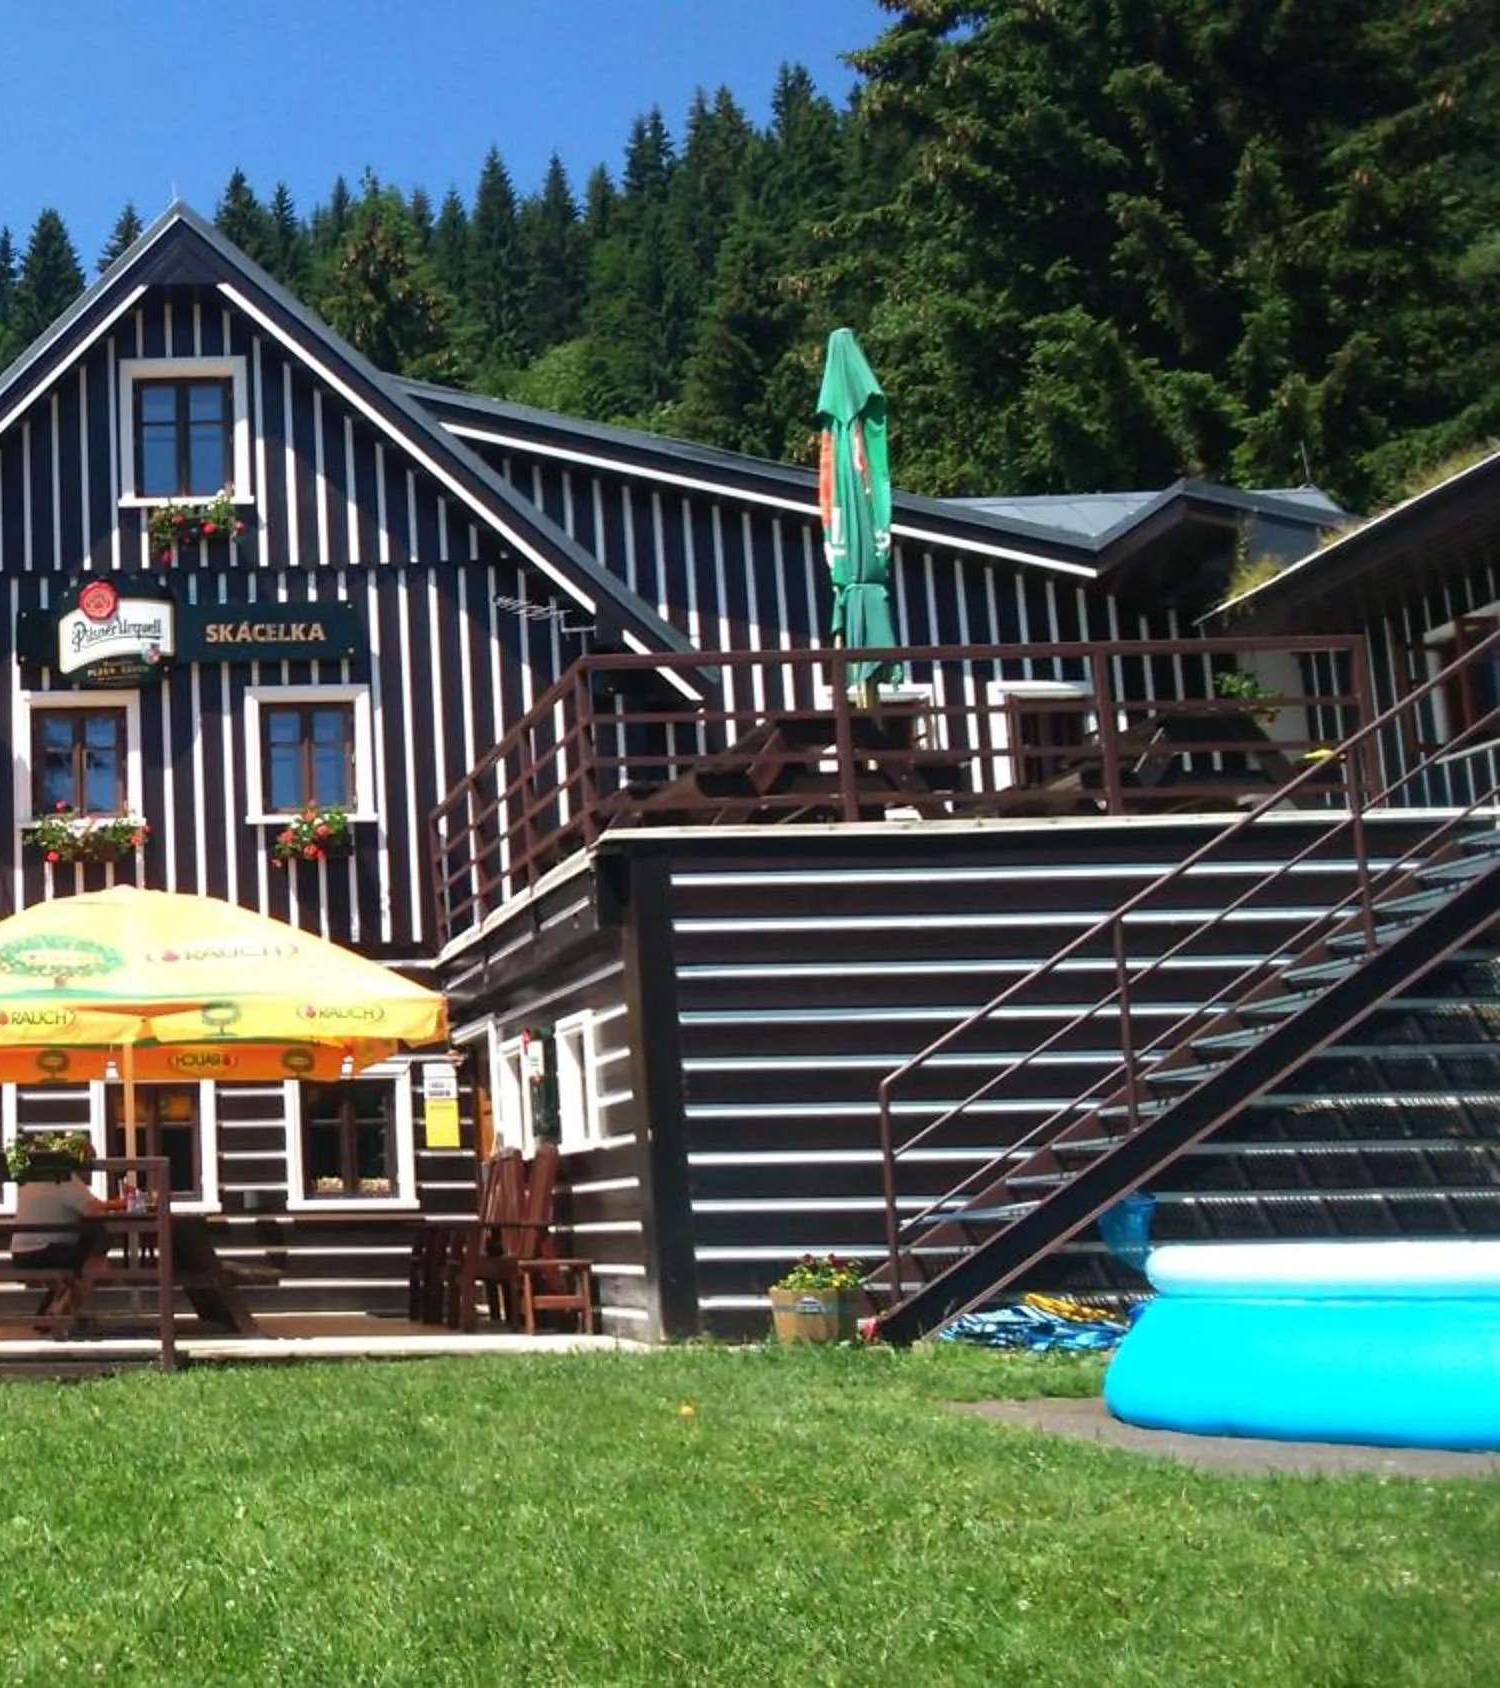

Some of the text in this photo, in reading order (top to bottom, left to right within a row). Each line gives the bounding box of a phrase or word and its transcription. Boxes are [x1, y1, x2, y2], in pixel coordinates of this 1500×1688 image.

[116, 615, 162, 640] Urquell
[205, 621, 326, 642] SKÁCELKA
[11, 1009, 67, 1025] RAUCH
[319, 1006, 375, 1020] RAUCH
